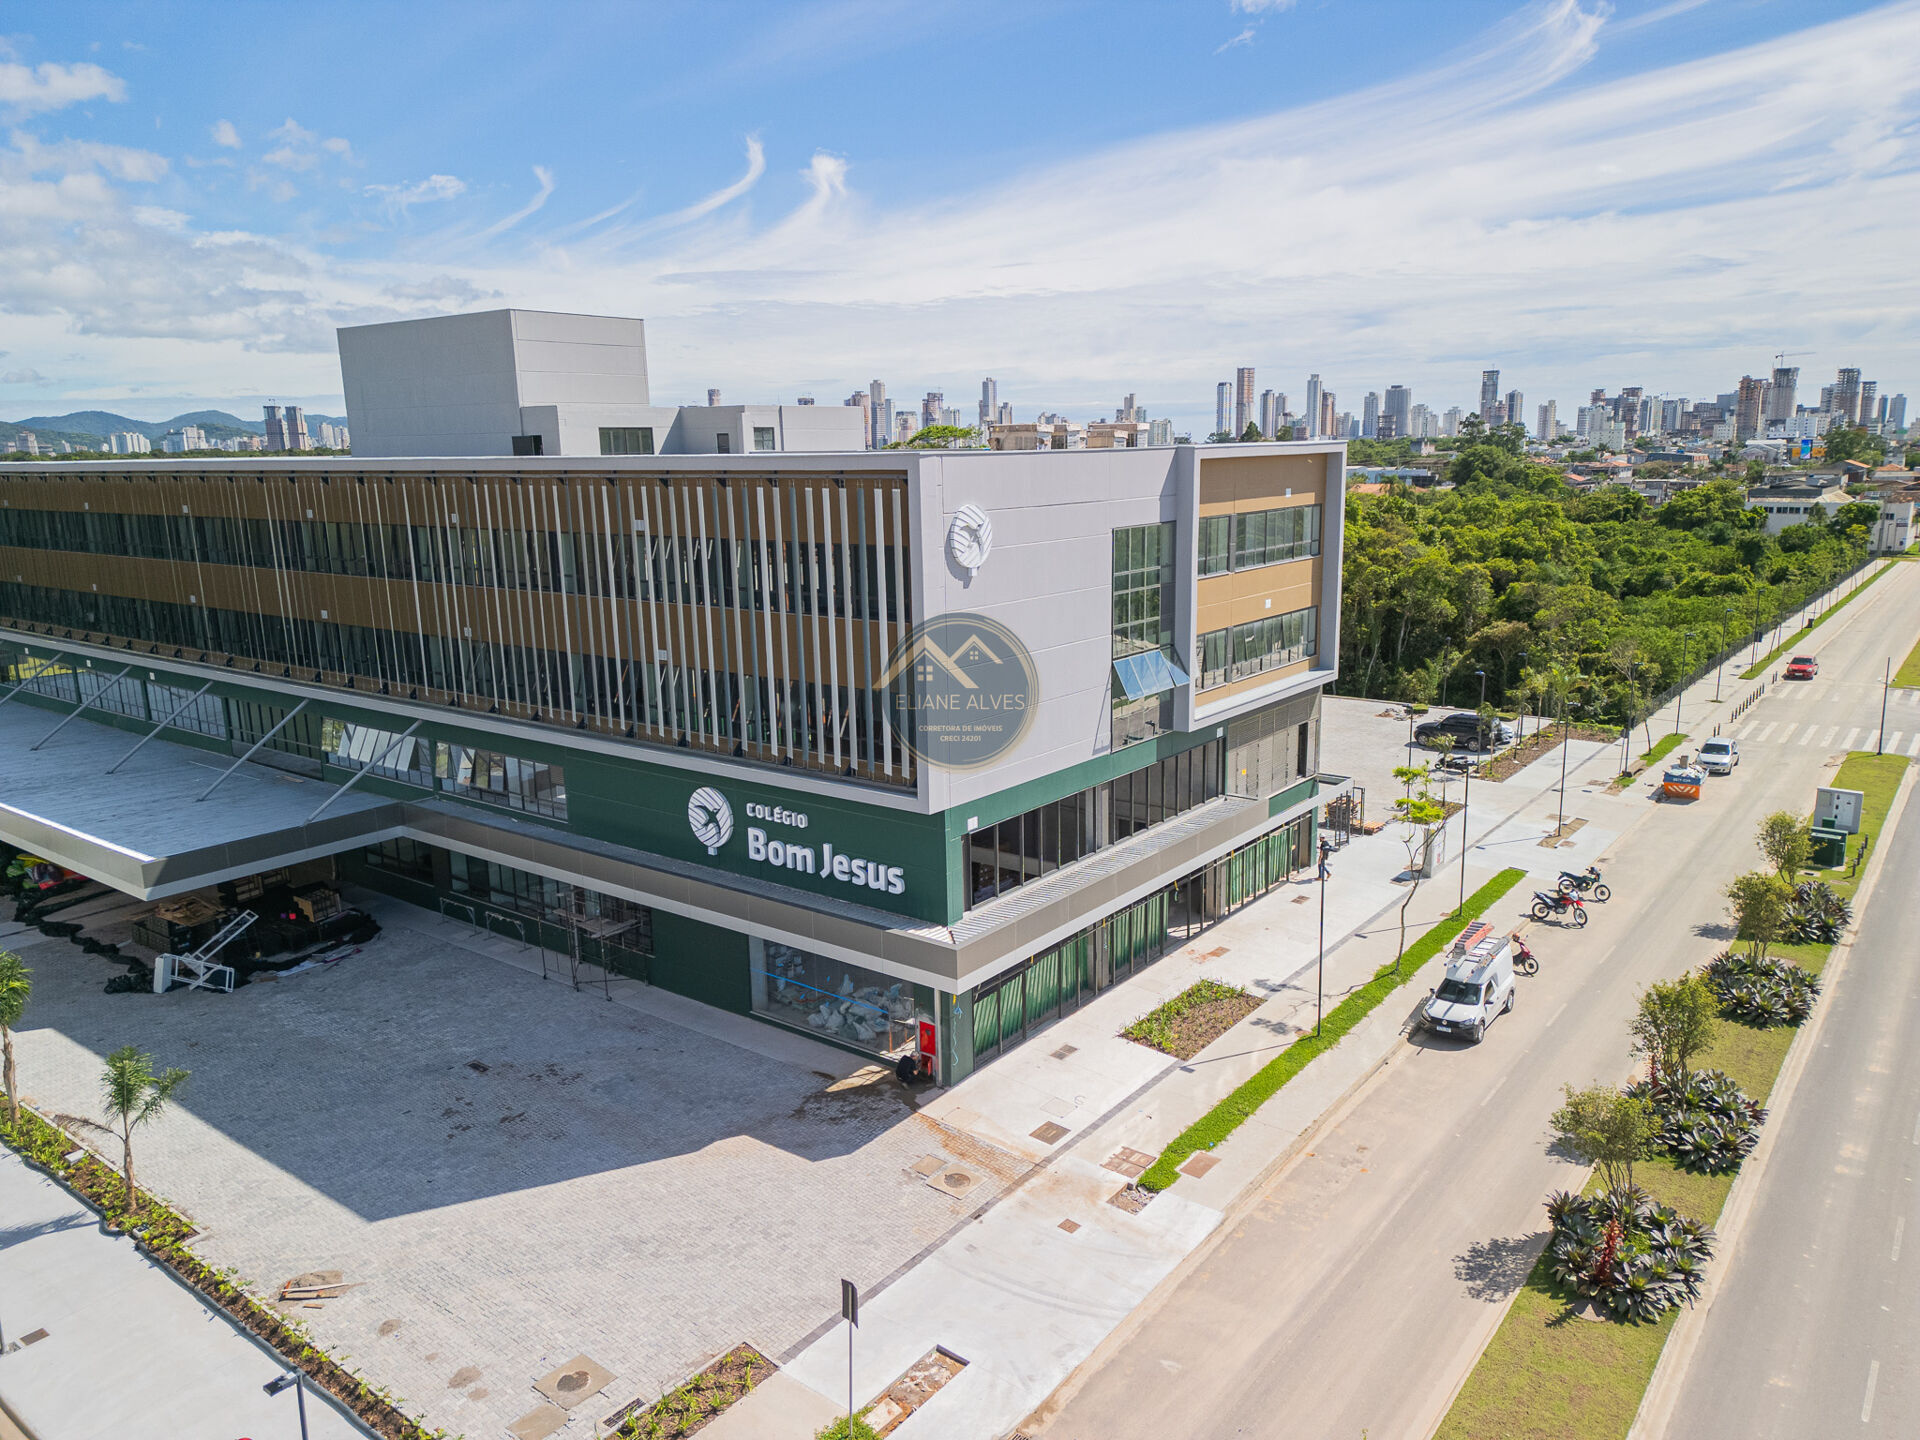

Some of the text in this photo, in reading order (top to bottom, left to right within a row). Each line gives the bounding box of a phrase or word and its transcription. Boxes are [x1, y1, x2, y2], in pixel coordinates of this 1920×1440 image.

[746, 802, 808, 829] COLÉGIO
[747, 827, 905, 895] Bom Jesus
